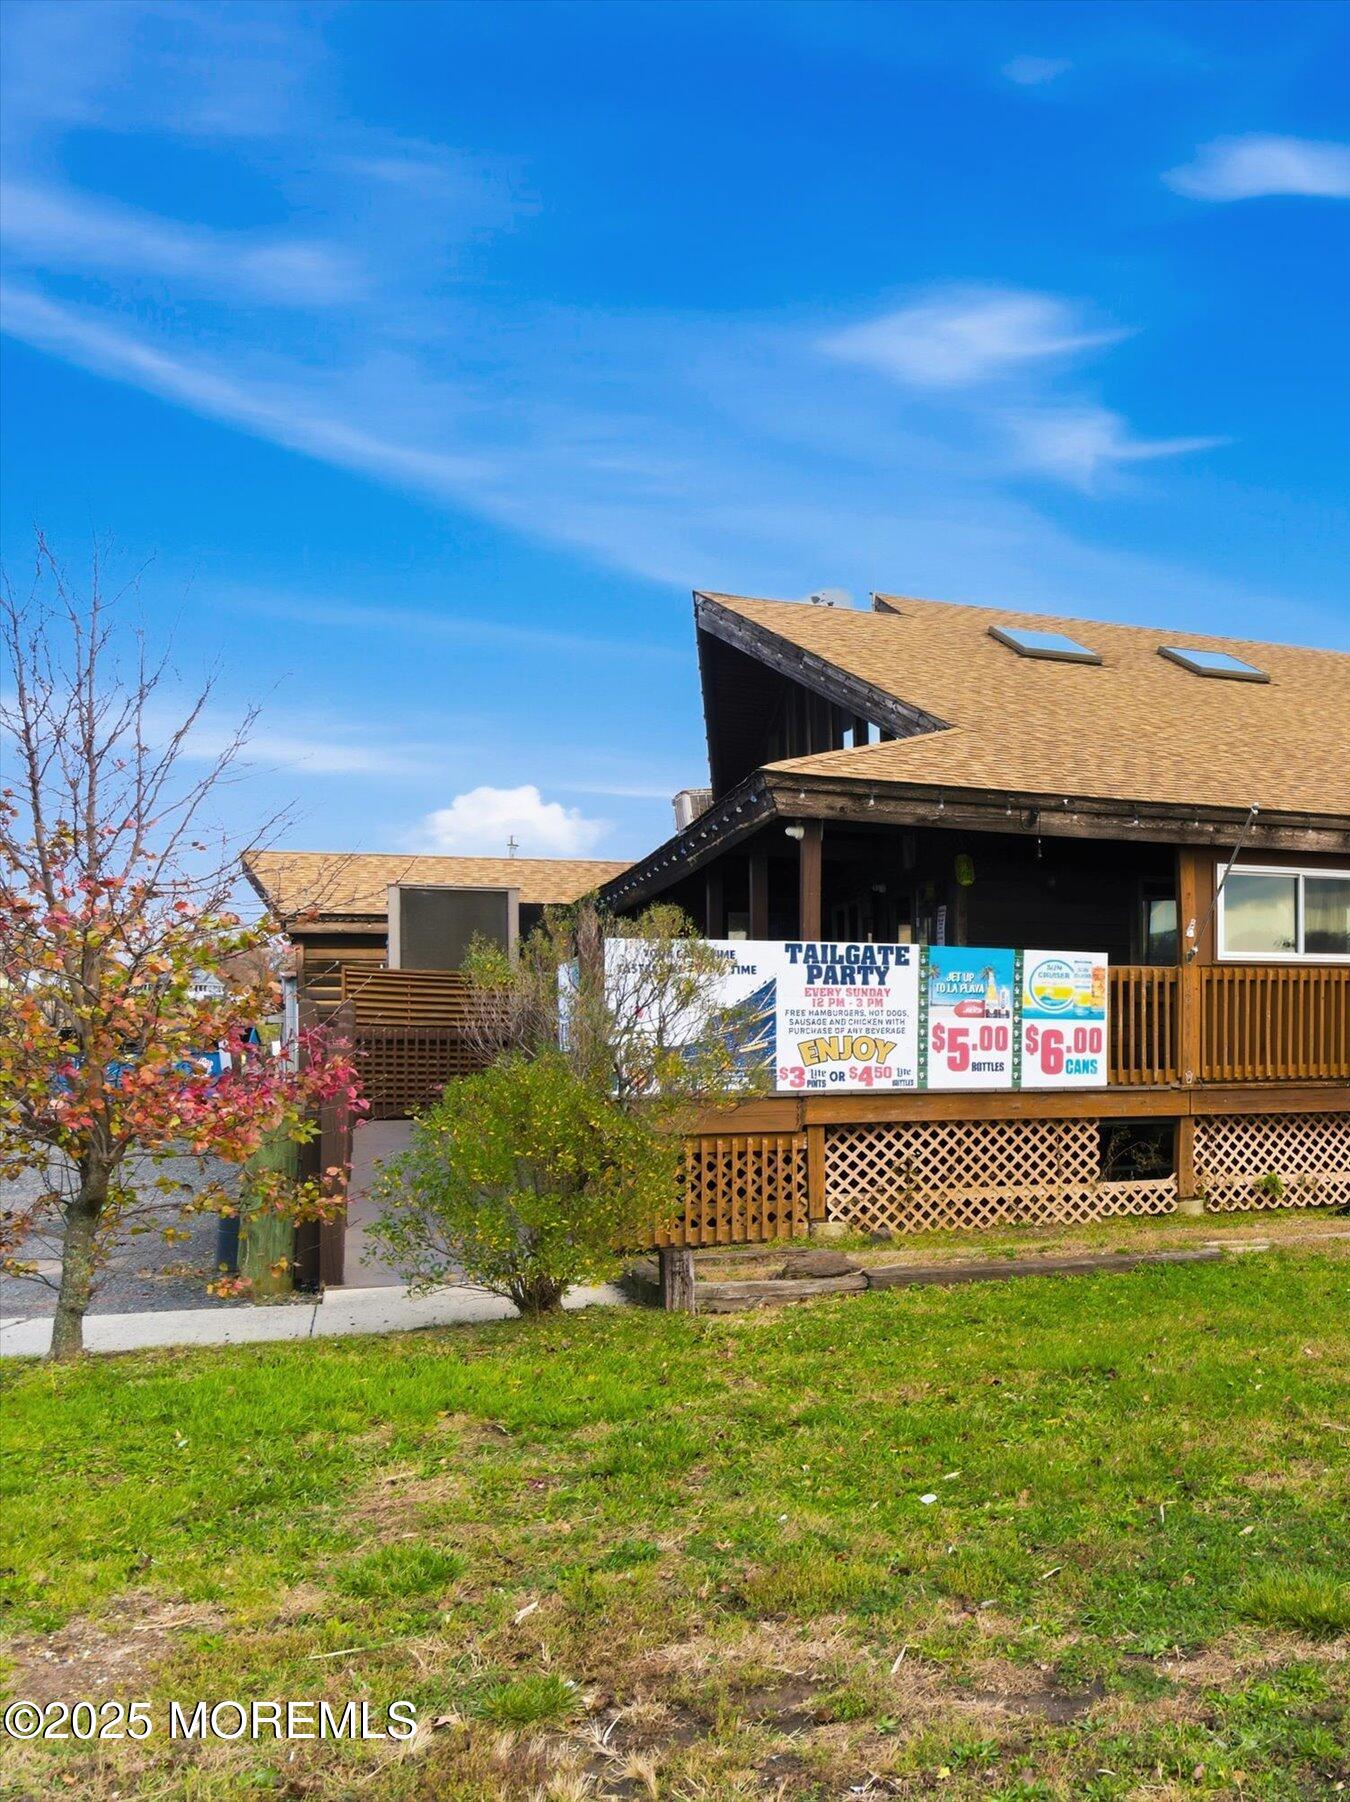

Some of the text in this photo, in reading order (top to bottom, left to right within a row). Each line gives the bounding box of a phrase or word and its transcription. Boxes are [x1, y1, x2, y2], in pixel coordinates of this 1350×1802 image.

[785, 943, 910, 966] TAILGATE
[731, 965, 757, 975] TIME
[806, 965, 890, 985] PARTY
[963, 972, 975, 982] UP
[804, 987, 891, 997] EVERY SUNDAY
[947, 982, 958, 993] LA
[812, 998, 823, 1007] 12
[828, 998, 845, 1007] PM
[857, 998, 863, 1007] 3
[867, 999, 884, 1008] PM
[789, 1018, 827, 1026] SAUSAGE
[848, 1018, 883, 1026] CHICKEN
[885, 1018, 905, 1026] WITH
[788, 1027, 832, 1035] PURCHASE
[865, 1027, 906, 1035] BEVERAGE
[797, 1035, 897, 1067] ENJOY
[931, 1022, 1009, 1072] $5.00
[1025, 1024, 1103, 1075] $6.00
[971, 1061, 1005, 1072] BOTTLES
[1065, 1059, 1098, 1074] CANS
[779, 1066, 805, 1088] $3
[829, 1071, 846, 1082] OR
